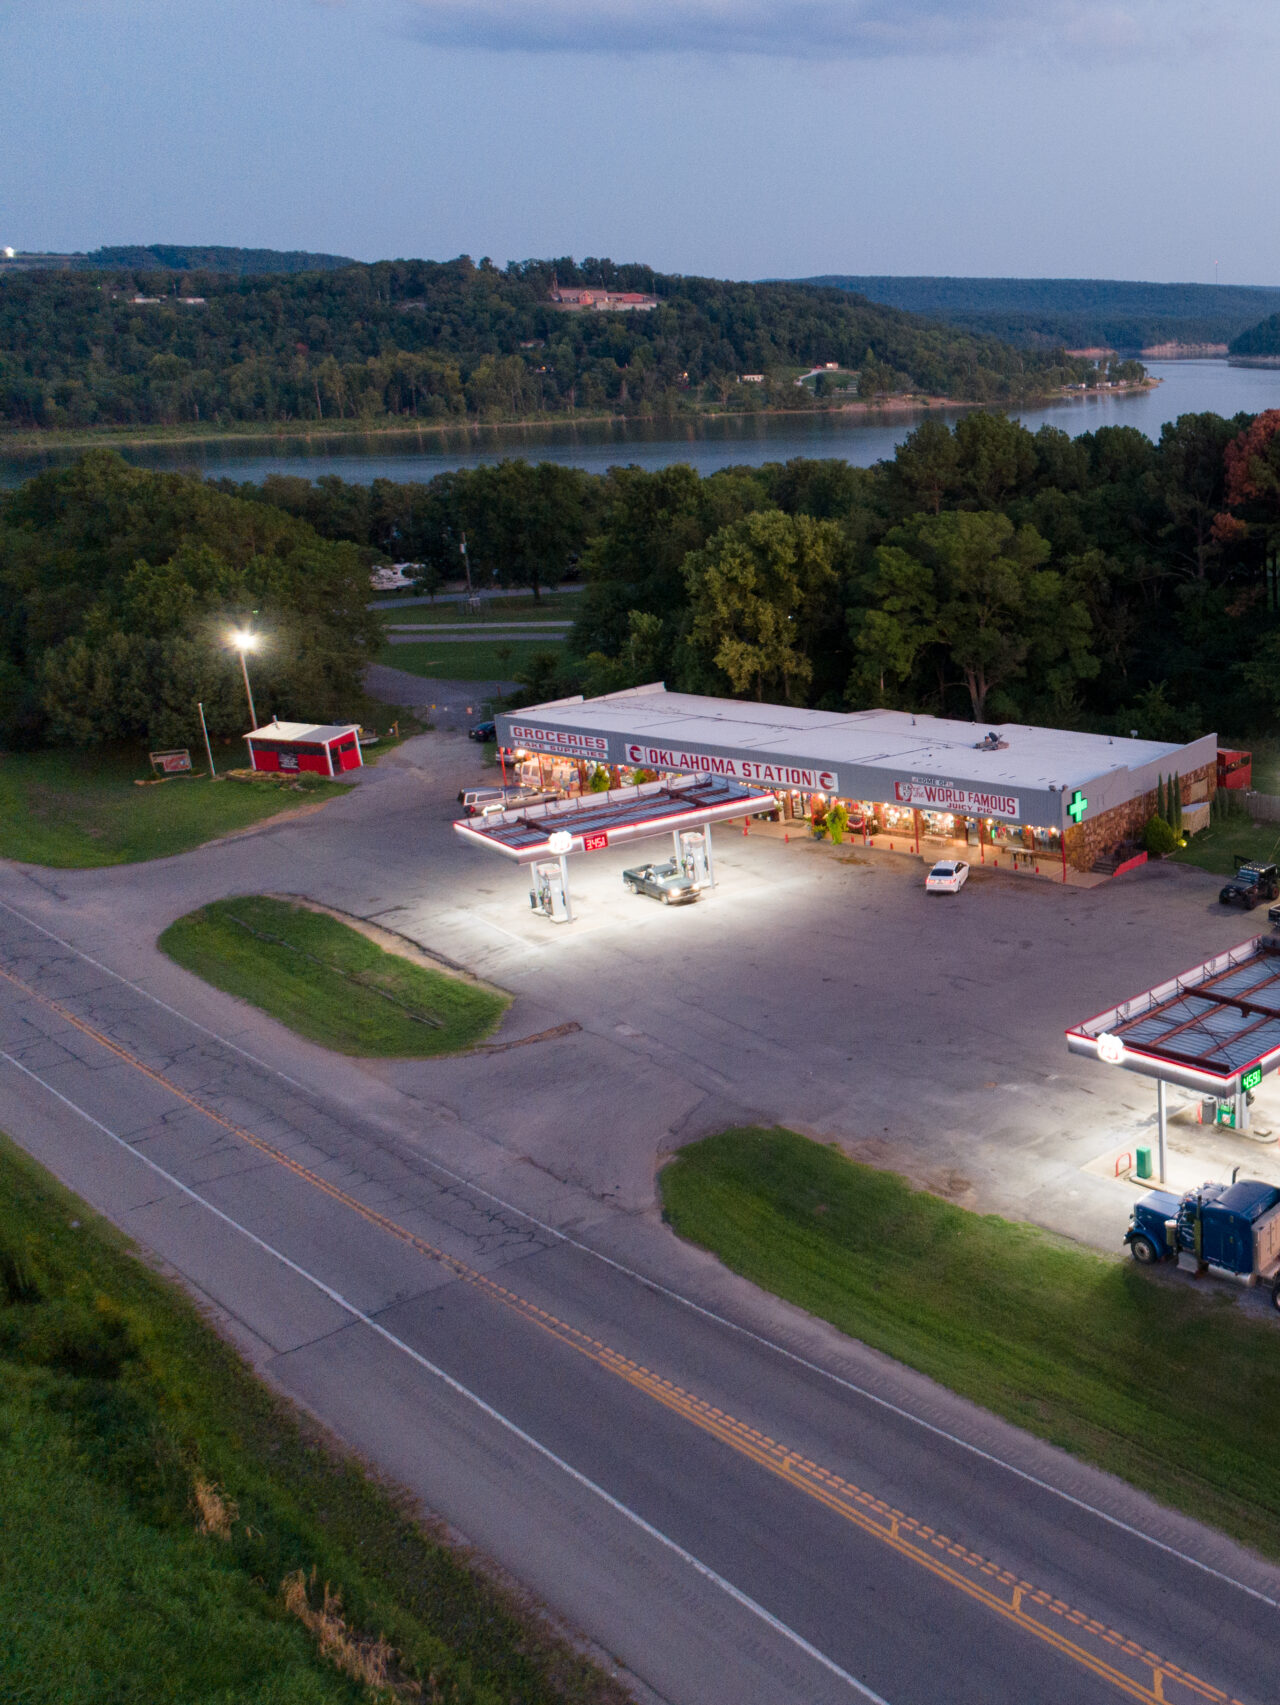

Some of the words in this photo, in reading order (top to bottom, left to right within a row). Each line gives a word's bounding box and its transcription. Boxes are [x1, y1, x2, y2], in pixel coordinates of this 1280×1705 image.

[513, 727, 606, 749] GROCERIES
[517, 741, 545, 750] LAKE
[549, 745, 605, 758] SUPPLIES
[650, 749, 736, 775] OKLAHOMA
[743, 762, 813, 786] STATION
[924, 785, 965, 802] WORLD
[968, 791, 1016, 815] FAMOUS
[946, 802, 973, 811] JUICY
[977, 806, 993, 814] PIG
